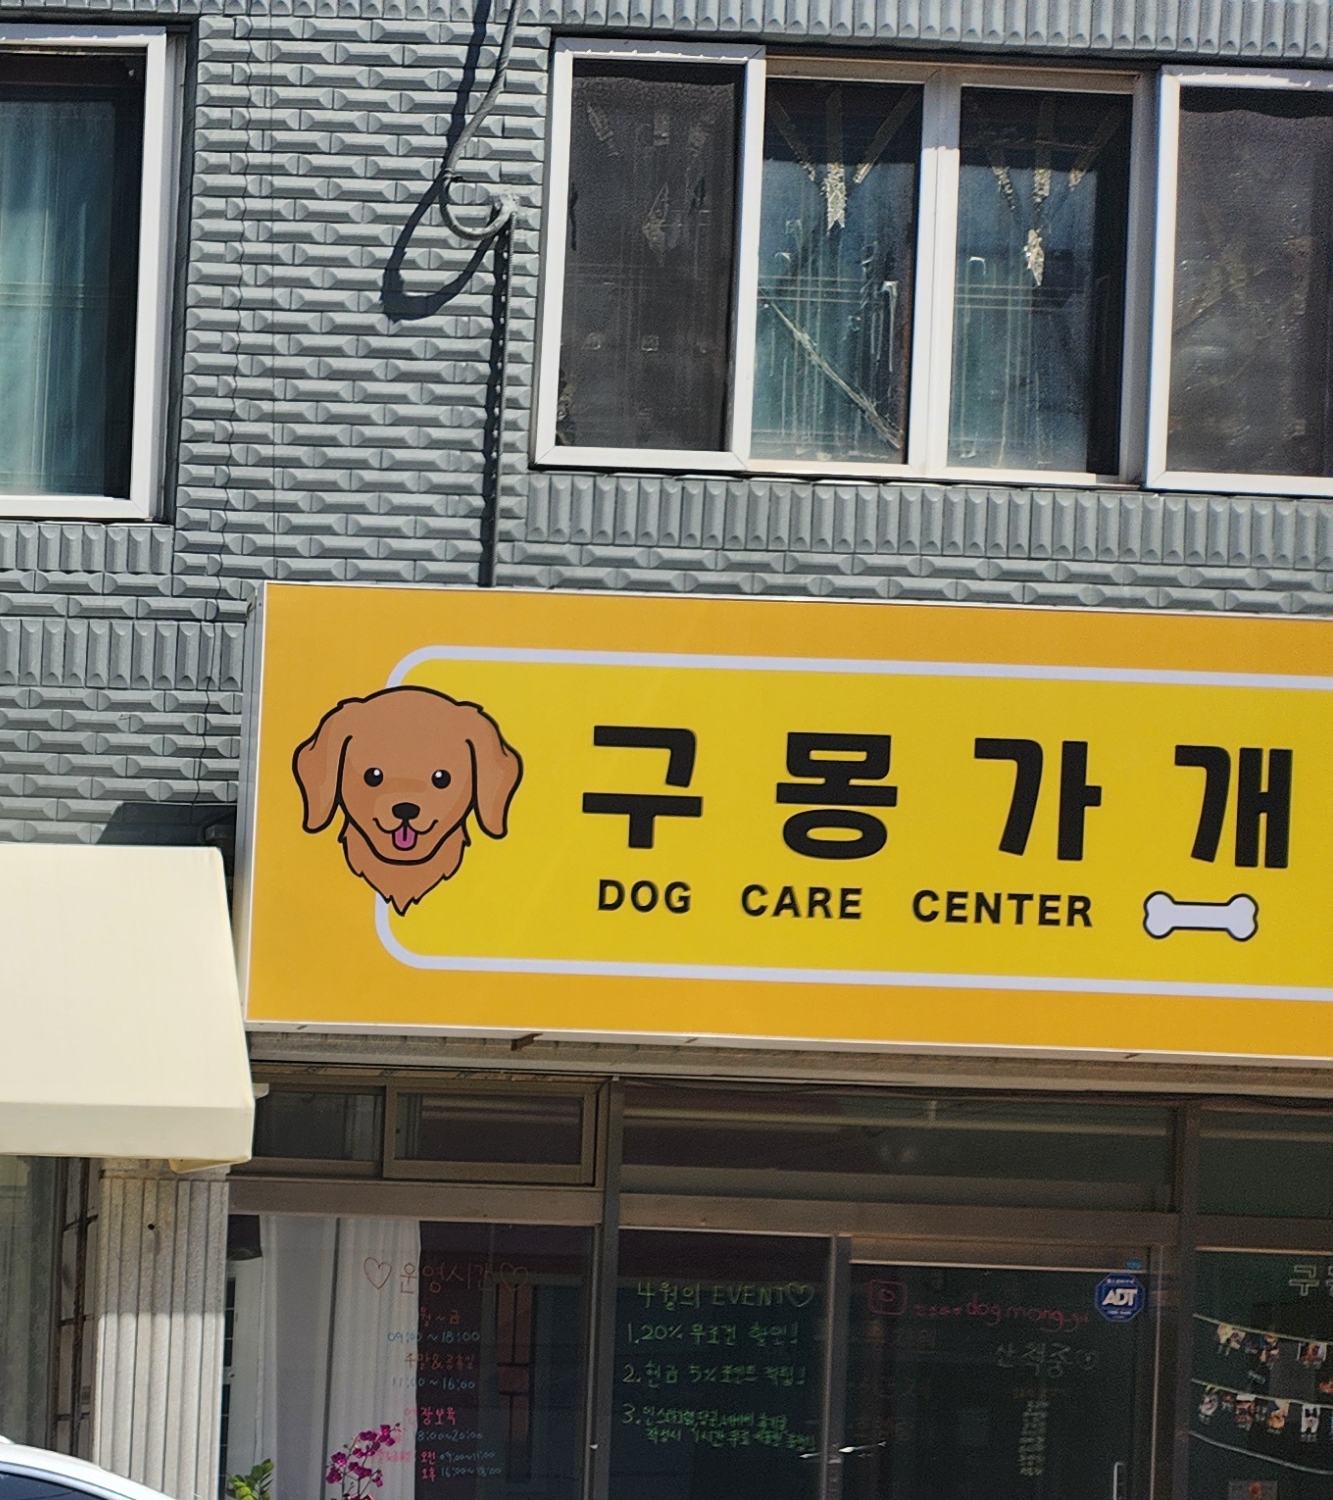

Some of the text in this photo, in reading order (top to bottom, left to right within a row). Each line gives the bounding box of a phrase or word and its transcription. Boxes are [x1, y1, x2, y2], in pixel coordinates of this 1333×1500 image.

[581, 725, 1292, 871] 구몽가개
[596, 878, 1094, 929] DOG CARE CENTER
[399, 1261, 493, 1294] 운영시간
[637, 1280, 784, 1311] 4월의 EVENT
[1102, 1288, 1139, 1307] ADT
